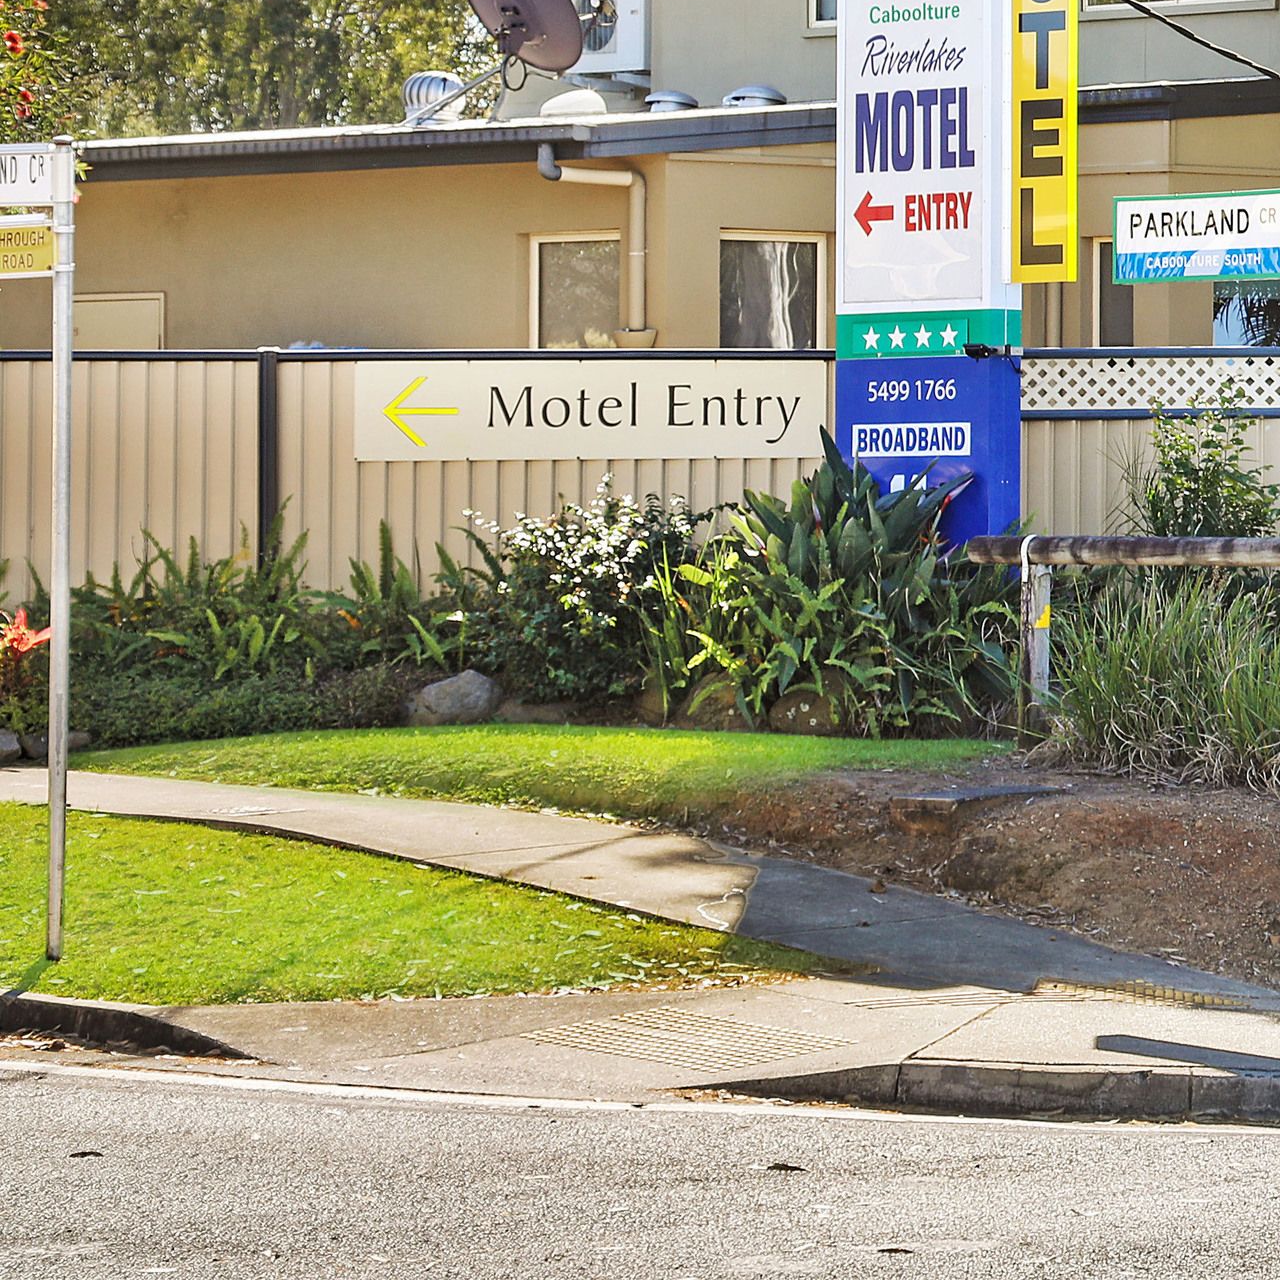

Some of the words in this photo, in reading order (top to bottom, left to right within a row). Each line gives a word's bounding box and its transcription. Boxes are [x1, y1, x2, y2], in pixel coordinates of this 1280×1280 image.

[869, 2, 960, 24] Caboolture
[861, 34, 966, 77] Riverlakes
[855, 87, 975, 174] MOTEL
[29, 154, 44, 183] CR
[905, 191, 972, 232] ENTRY
[1129, 208, 1250, 239] PARKLAND
[1259, 207, 1277, 224] CR
[3, 253, 33, 269] ROAD
[1146, 253, 1221, 269] CABOOLTURE
[1224, 252, 1261, 267] SOUTH
[867, 381, 909, 402] 5499
[914, 379, 956, 400] 1766
[487, 382, 637, 428] Motel
[667, 384, 800, 444] Entry
[857, 426, 965, 452] BROADBAND
